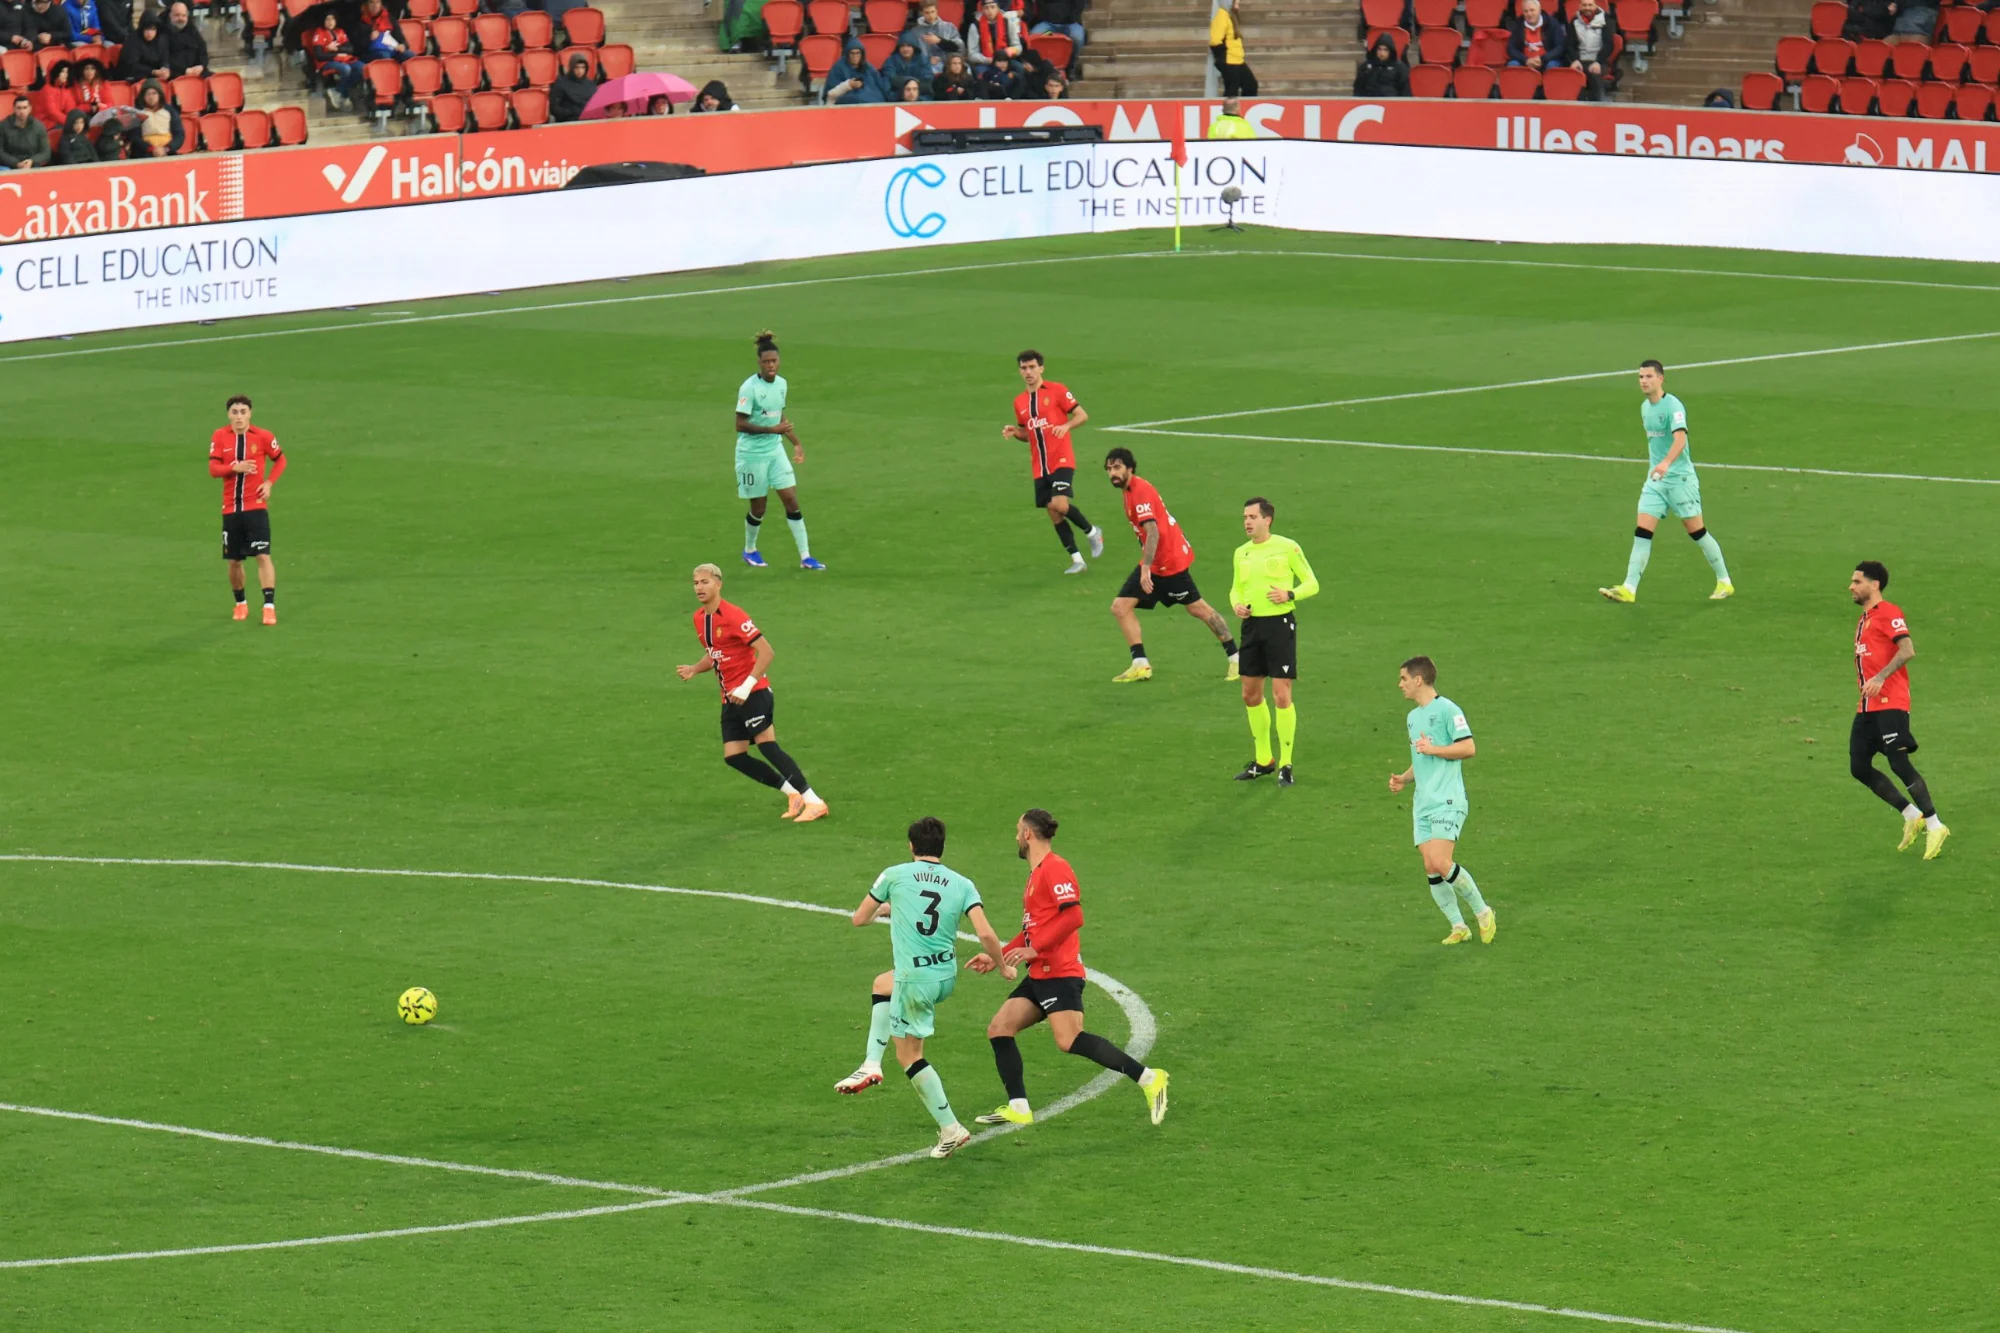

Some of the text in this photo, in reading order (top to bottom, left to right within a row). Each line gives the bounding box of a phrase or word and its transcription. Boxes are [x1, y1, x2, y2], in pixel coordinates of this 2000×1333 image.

[1496, 116, 1785, 160] Illes Balears
[391, 147, 588, 200] Halcón viaje
[959, 156, 1267, 198] CELL EDUCATION
[0, 169, 210, 242] CaixaBank
[1079, 198, 1126, 217] THE
[16, 235, 278, 291] CELL EDUCATION
[134, 277, 278, 309] THE INSTITUTE
[742, 472, 754, 486] 10
[1135, 502, 1152, 513] OK
[913, 872, 949, 887] VIVIAN
[1053, 882, 1075, 895] OK
[916, 889, 942, 936] 3
